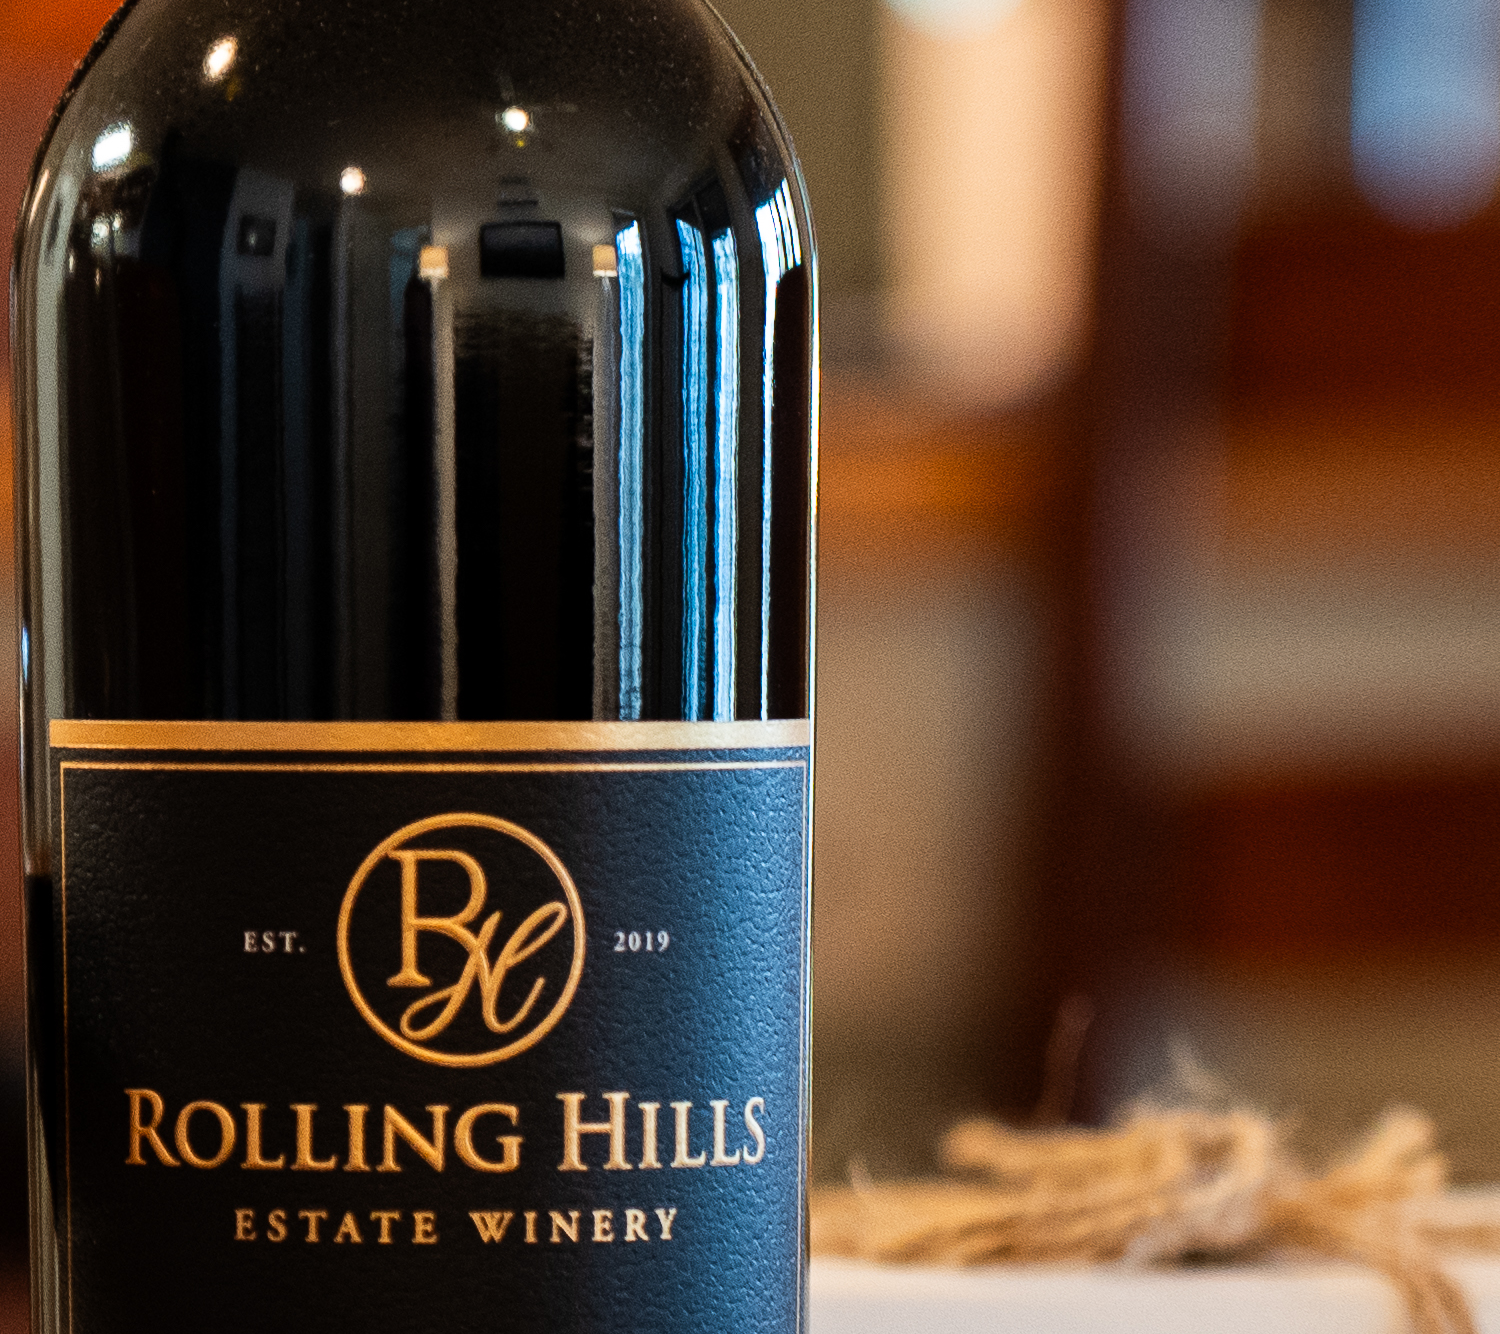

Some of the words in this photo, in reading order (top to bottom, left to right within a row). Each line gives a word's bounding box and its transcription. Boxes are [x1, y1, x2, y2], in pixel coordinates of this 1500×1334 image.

[241, 929, 307, 955] EST.
[612, 929, 672, 954] 2019
[124, 1087, 525, 1174] ROLLING
[555, 1089, 768, 1173] HILLS
[234, 1207, 440, 1246] ESTATE
[467, 1206, 679, 1245] WINERY
